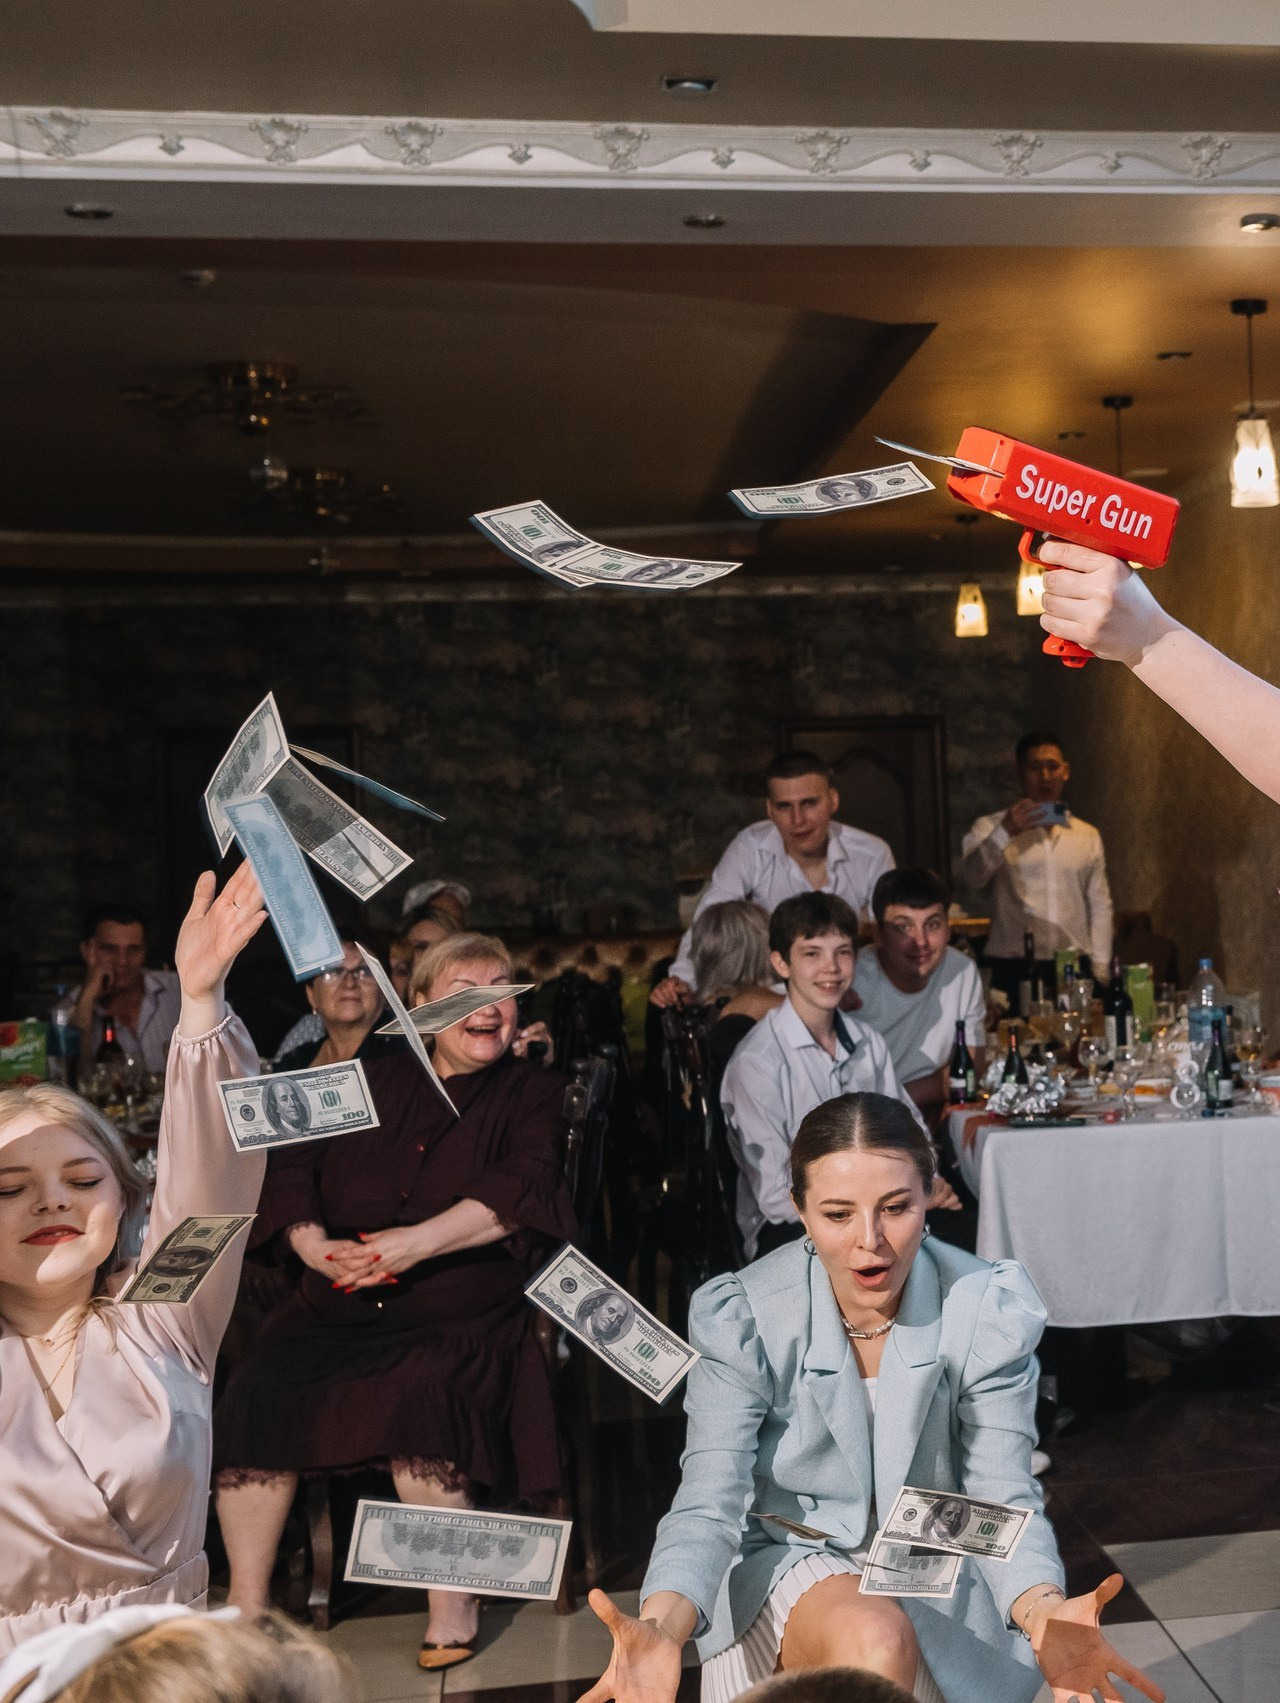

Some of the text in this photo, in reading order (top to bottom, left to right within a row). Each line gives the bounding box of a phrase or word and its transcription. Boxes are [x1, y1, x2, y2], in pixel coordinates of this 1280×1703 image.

[1015, 464, 1152, 539] Super Gun
[527, 509, 551, 523] 100
[341, 1110, 365, 1120] 100
[638, 1367, 661, 1387] 100
[404, 1513, 451, 1524] DOLLARS
[451, 1517, 499, 1529] HUNDRED
[498, 1522, 520, 1531] ONE
[984, 1542, 1005, 1551] 100
